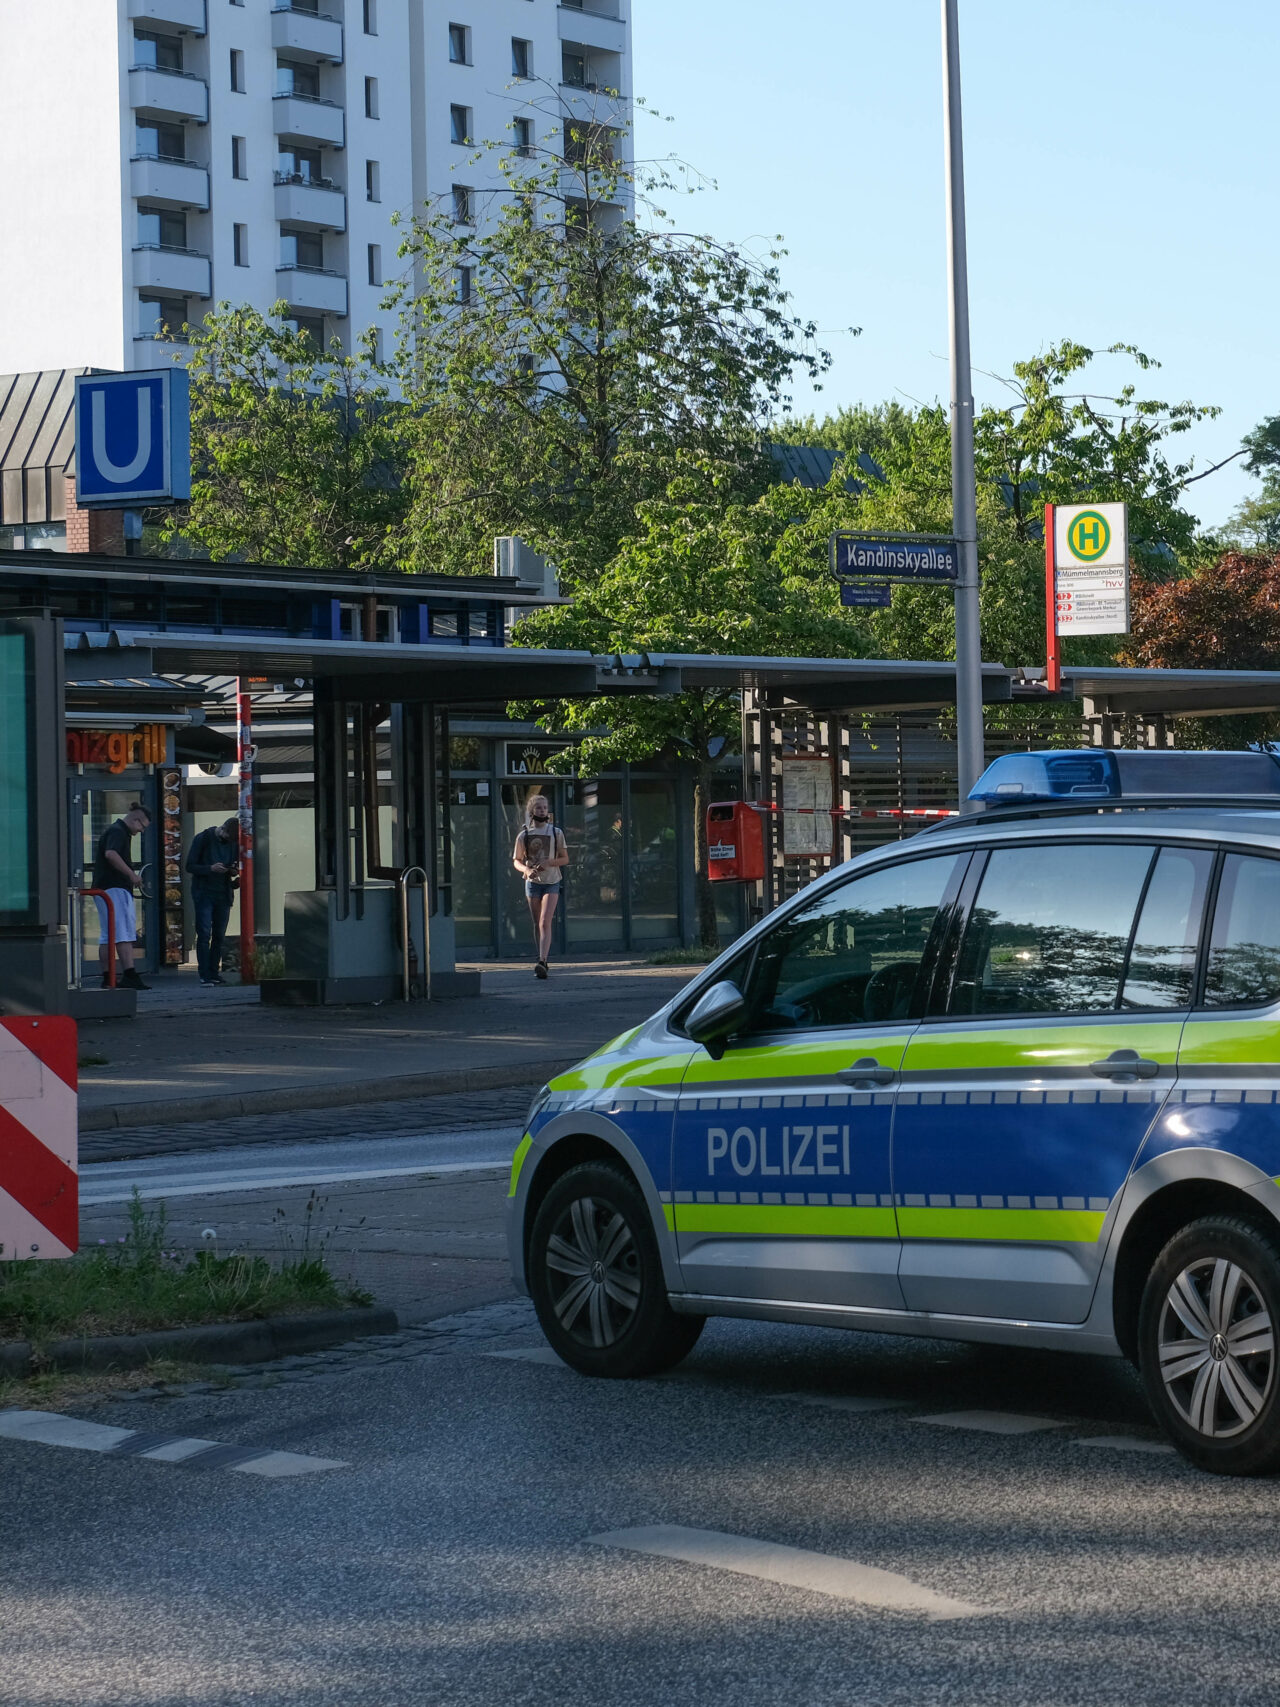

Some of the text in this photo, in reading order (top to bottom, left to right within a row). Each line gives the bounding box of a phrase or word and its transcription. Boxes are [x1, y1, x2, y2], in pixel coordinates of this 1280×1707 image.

[92, 387, 151, 483] U
[1079, 522, 1099, 550] H
[847, 544, 953, 573] Kandinskyallee
[1061, 568, 1124, 577] Mümmelmannsberg
[707, 1125, 850, 1176] POLIZEI
